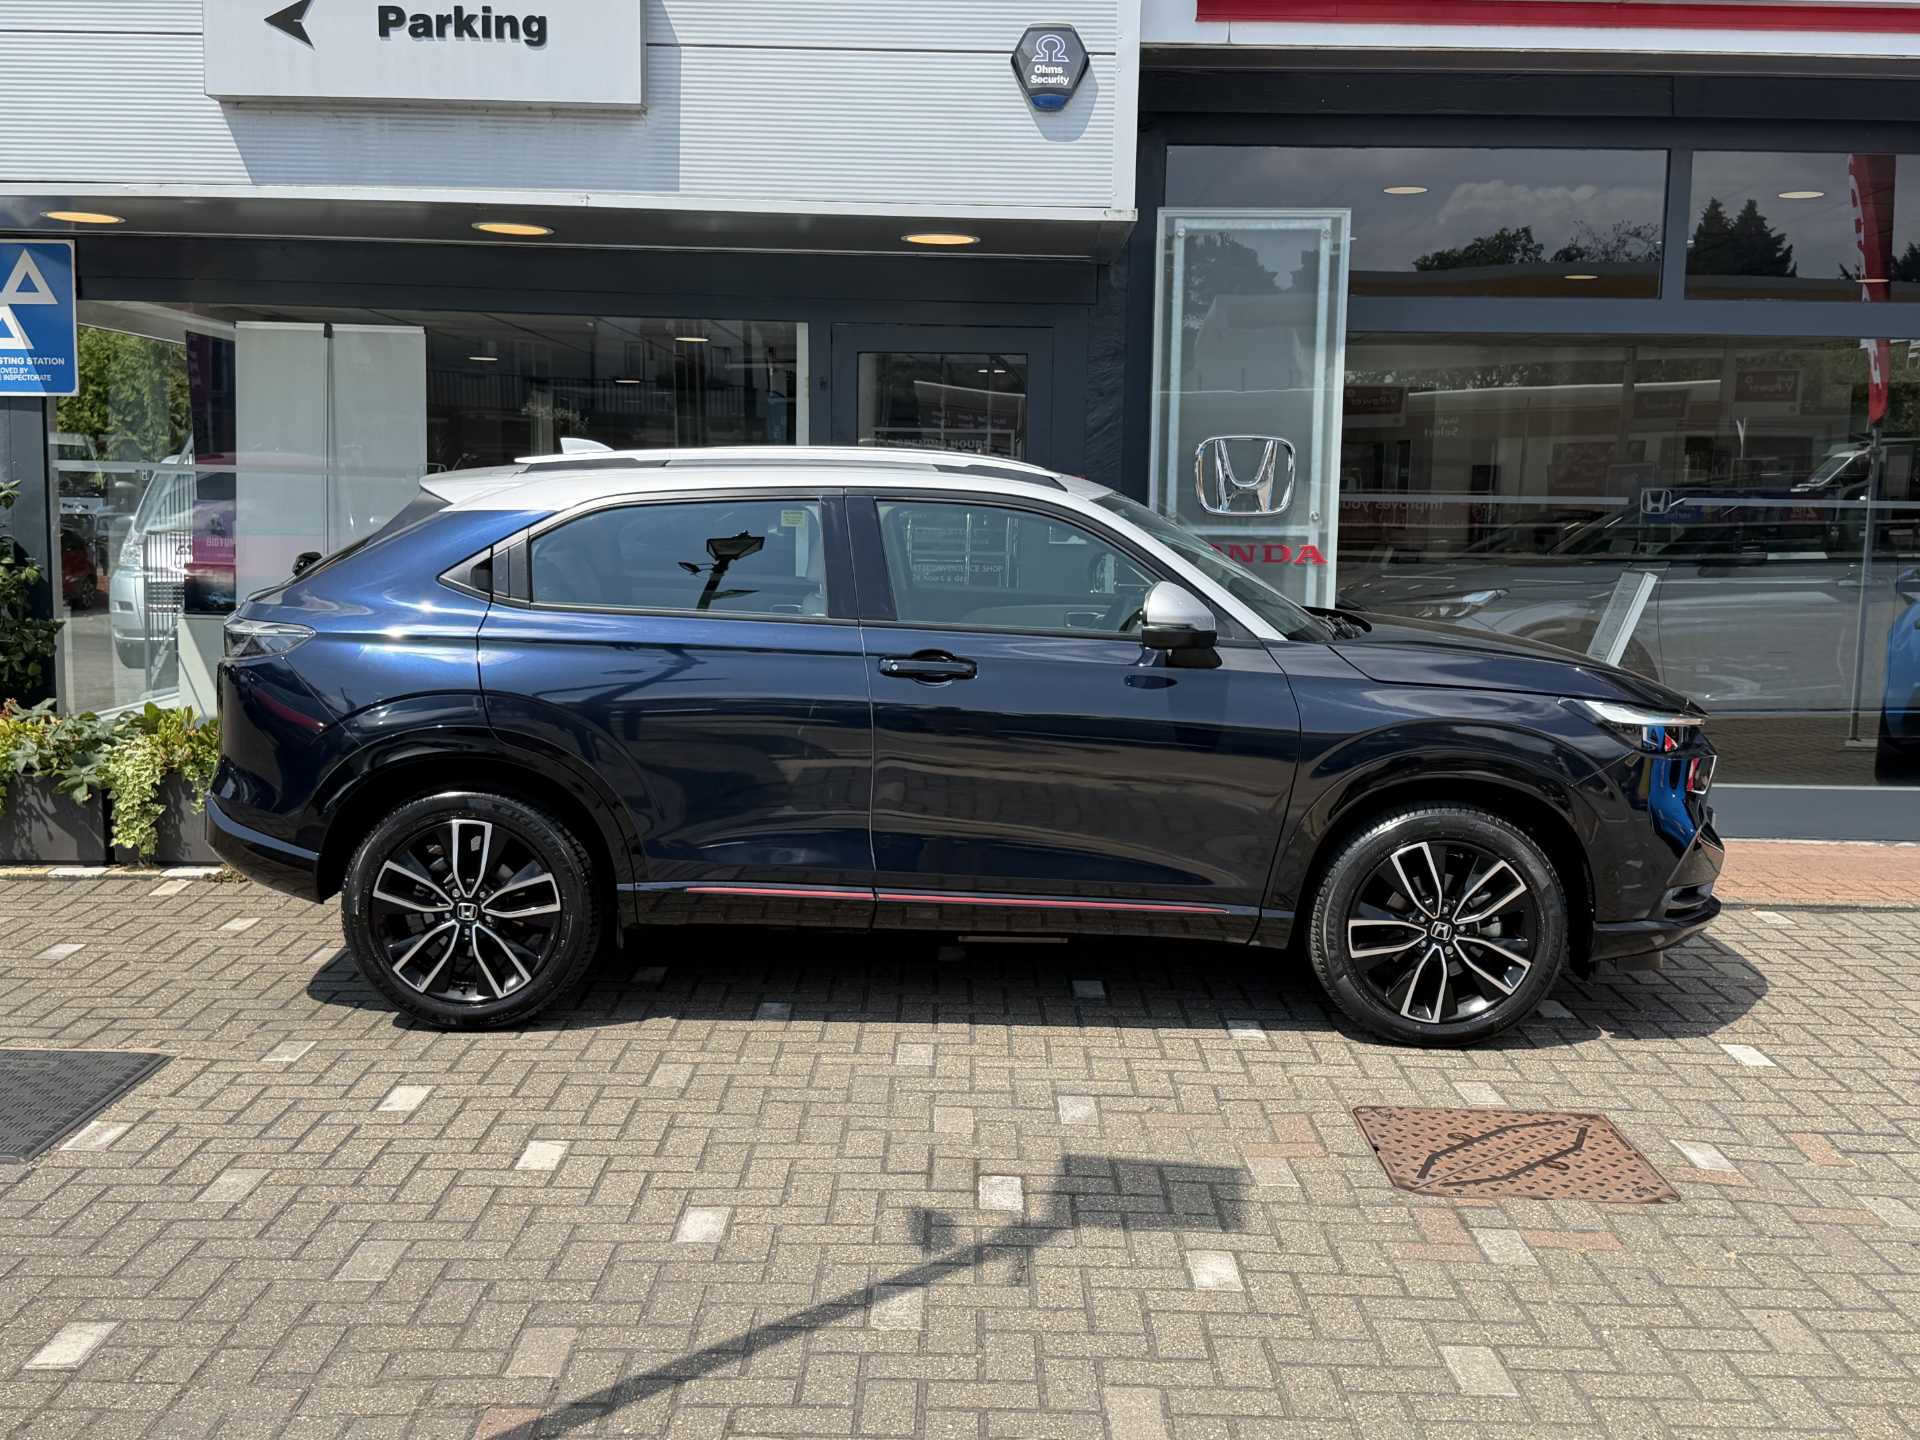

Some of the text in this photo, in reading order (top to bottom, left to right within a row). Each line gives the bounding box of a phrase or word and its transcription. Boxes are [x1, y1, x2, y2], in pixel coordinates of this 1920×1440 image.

[378, 6, 547, 48] Parking
[1034, 64, 1064, 74] Ohms
[1030, 75, 1069, 86] Security
[26, 356, 65, 366] STATION
[3, 374, 53, 382] INSPECTORATE
[1210, 543, 1329, 566] NDA
